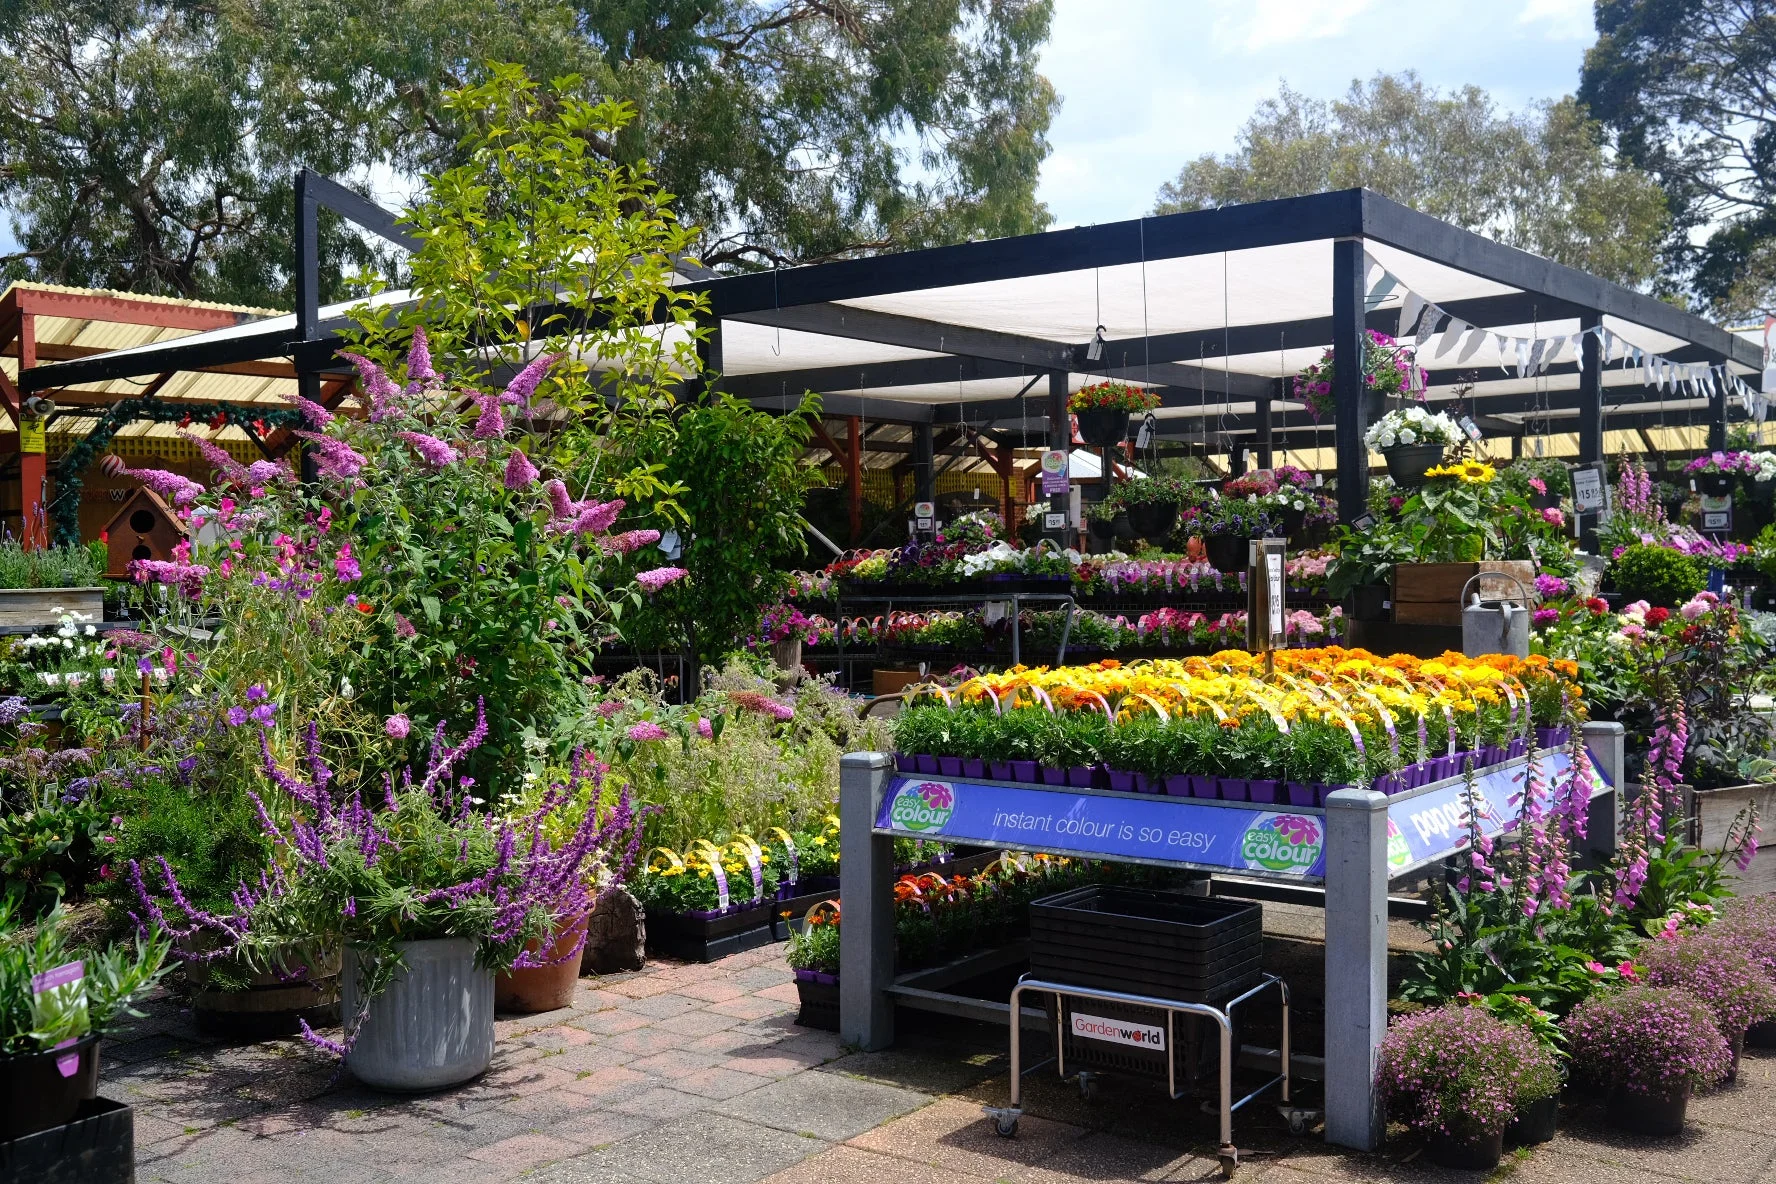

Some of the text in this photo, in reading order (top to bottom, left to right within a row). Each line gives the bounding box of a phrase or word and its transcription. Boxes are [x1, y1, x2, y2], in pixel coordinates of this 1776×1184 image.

[893, 805, 949, 825] colour
[897, 797, 920, 809] easy
[992, 807, 1217, 854] instant colour is so easy
[1247, 831, 1278, 845] easy
[1409, 806, 1450, 847] pop
[1244, 840, 1317, 864] colour
[1075, 1018, 1160, 1045] Gardenworld
